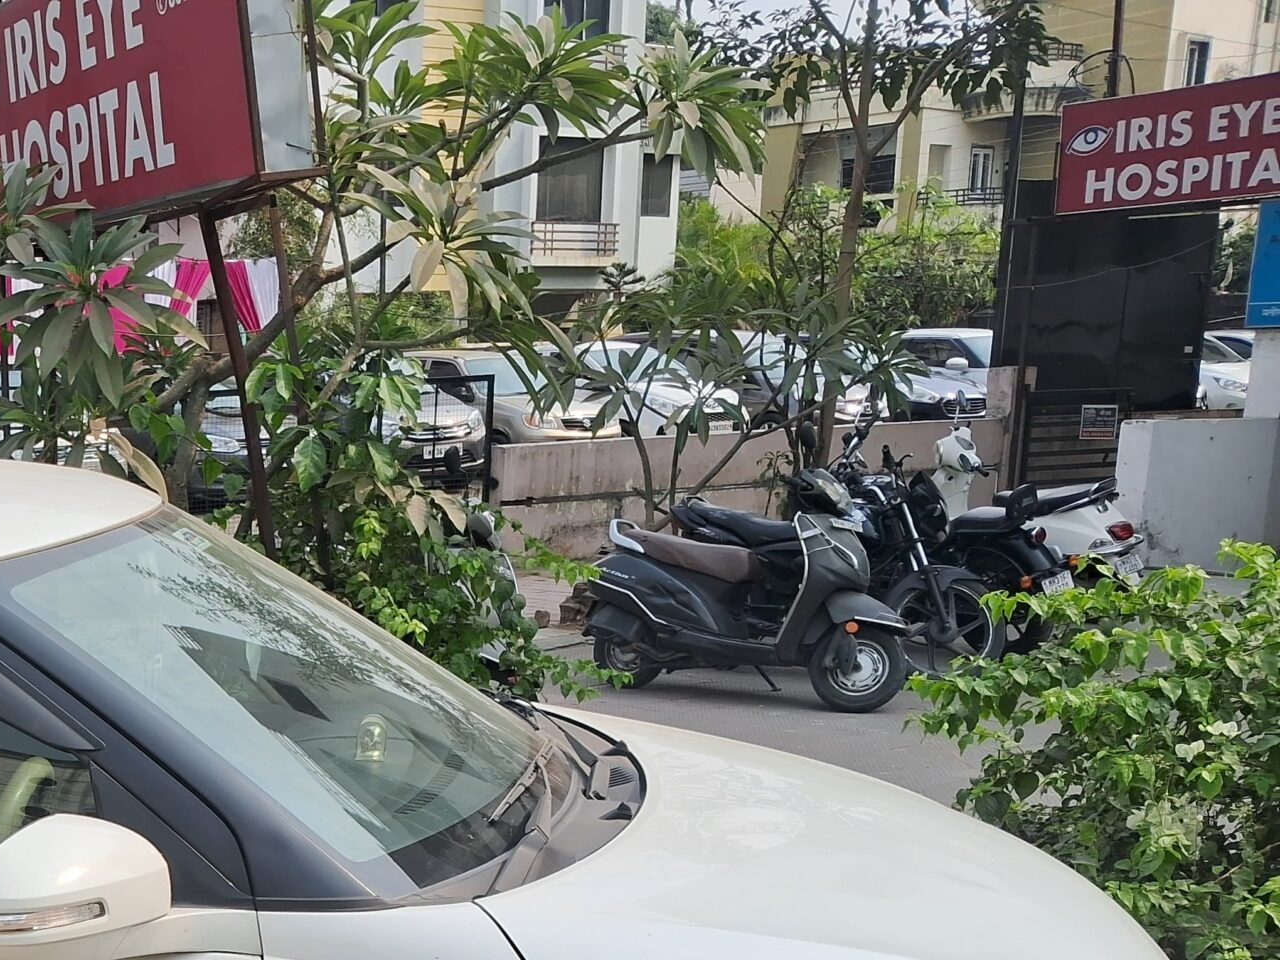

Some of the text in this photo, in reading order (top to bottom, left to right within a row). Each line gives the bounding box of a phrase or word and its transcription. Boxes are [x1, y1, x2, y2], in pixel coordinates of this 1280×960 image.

[4, 0, 144, 103] IRIS EYE
[1115, 98, 1280, 153] IRIS EYE
